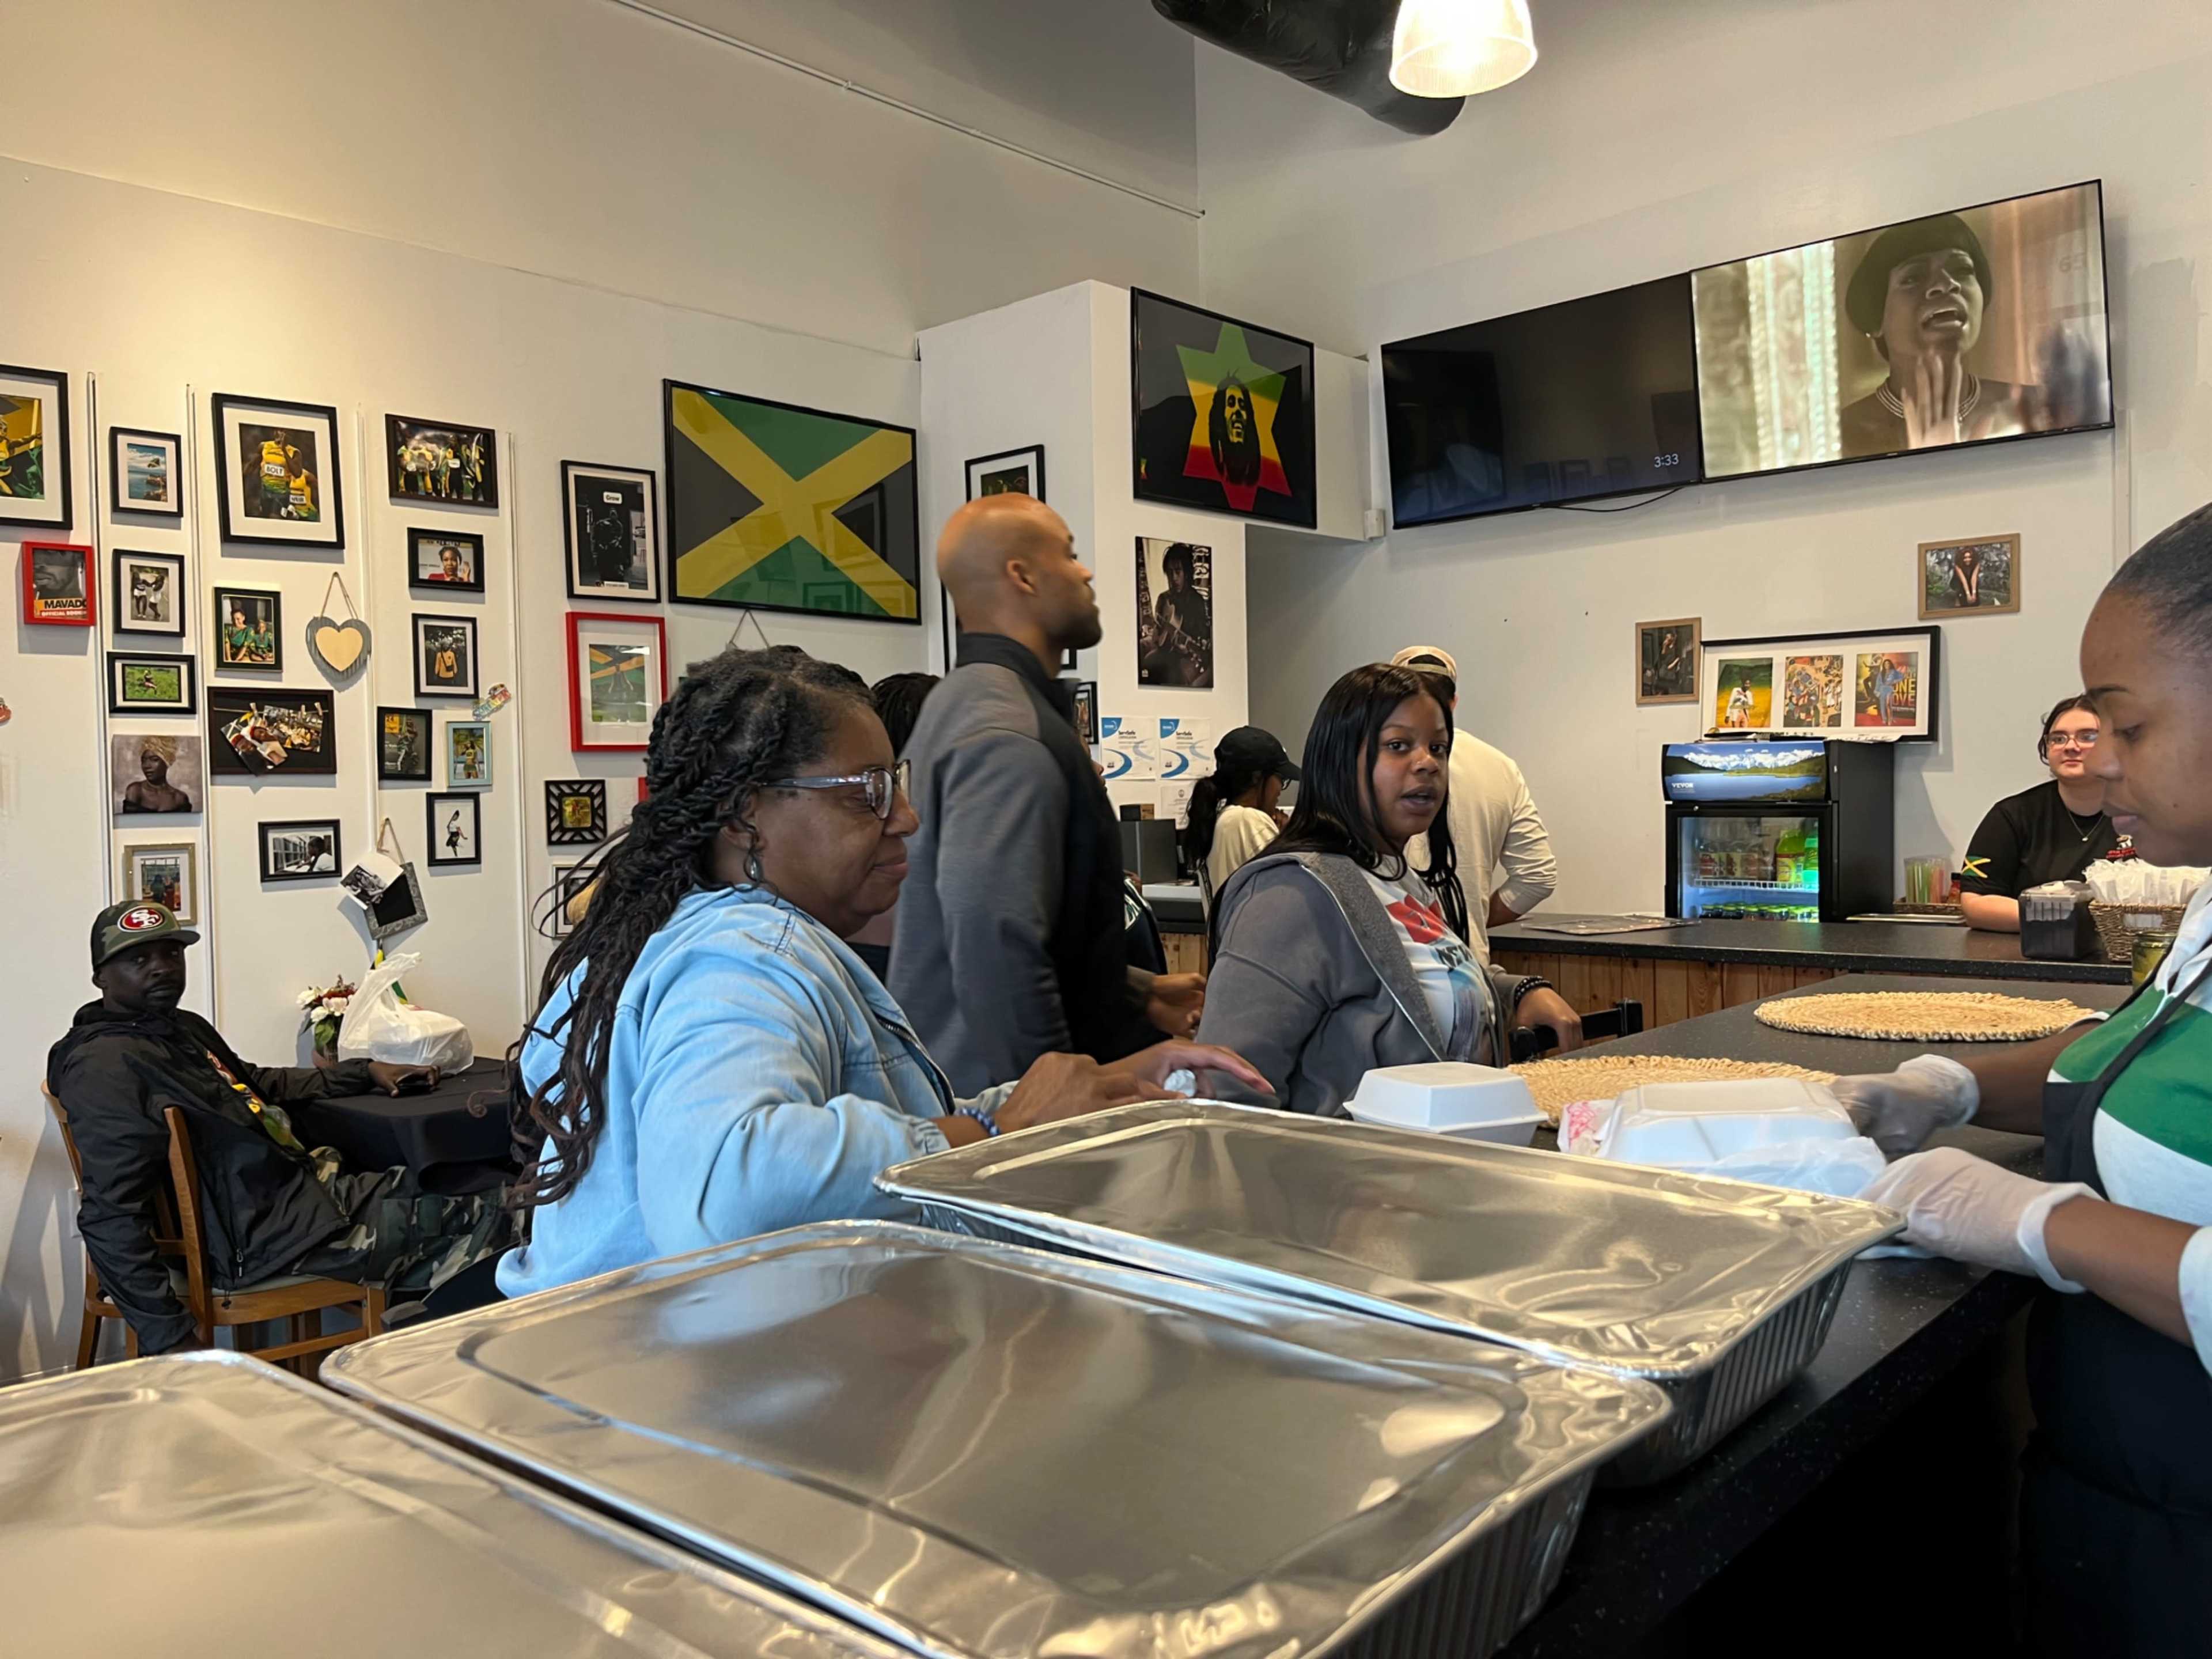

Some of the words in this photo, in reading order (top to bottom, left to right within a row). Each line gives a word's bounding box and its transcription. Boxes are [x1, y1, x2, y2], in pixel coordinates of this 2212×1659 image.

[1654, 453, 1679, 468] 3:33
[266, 465, 283, 475] BOLT
[1892, 693, 1916, 706] OVE
